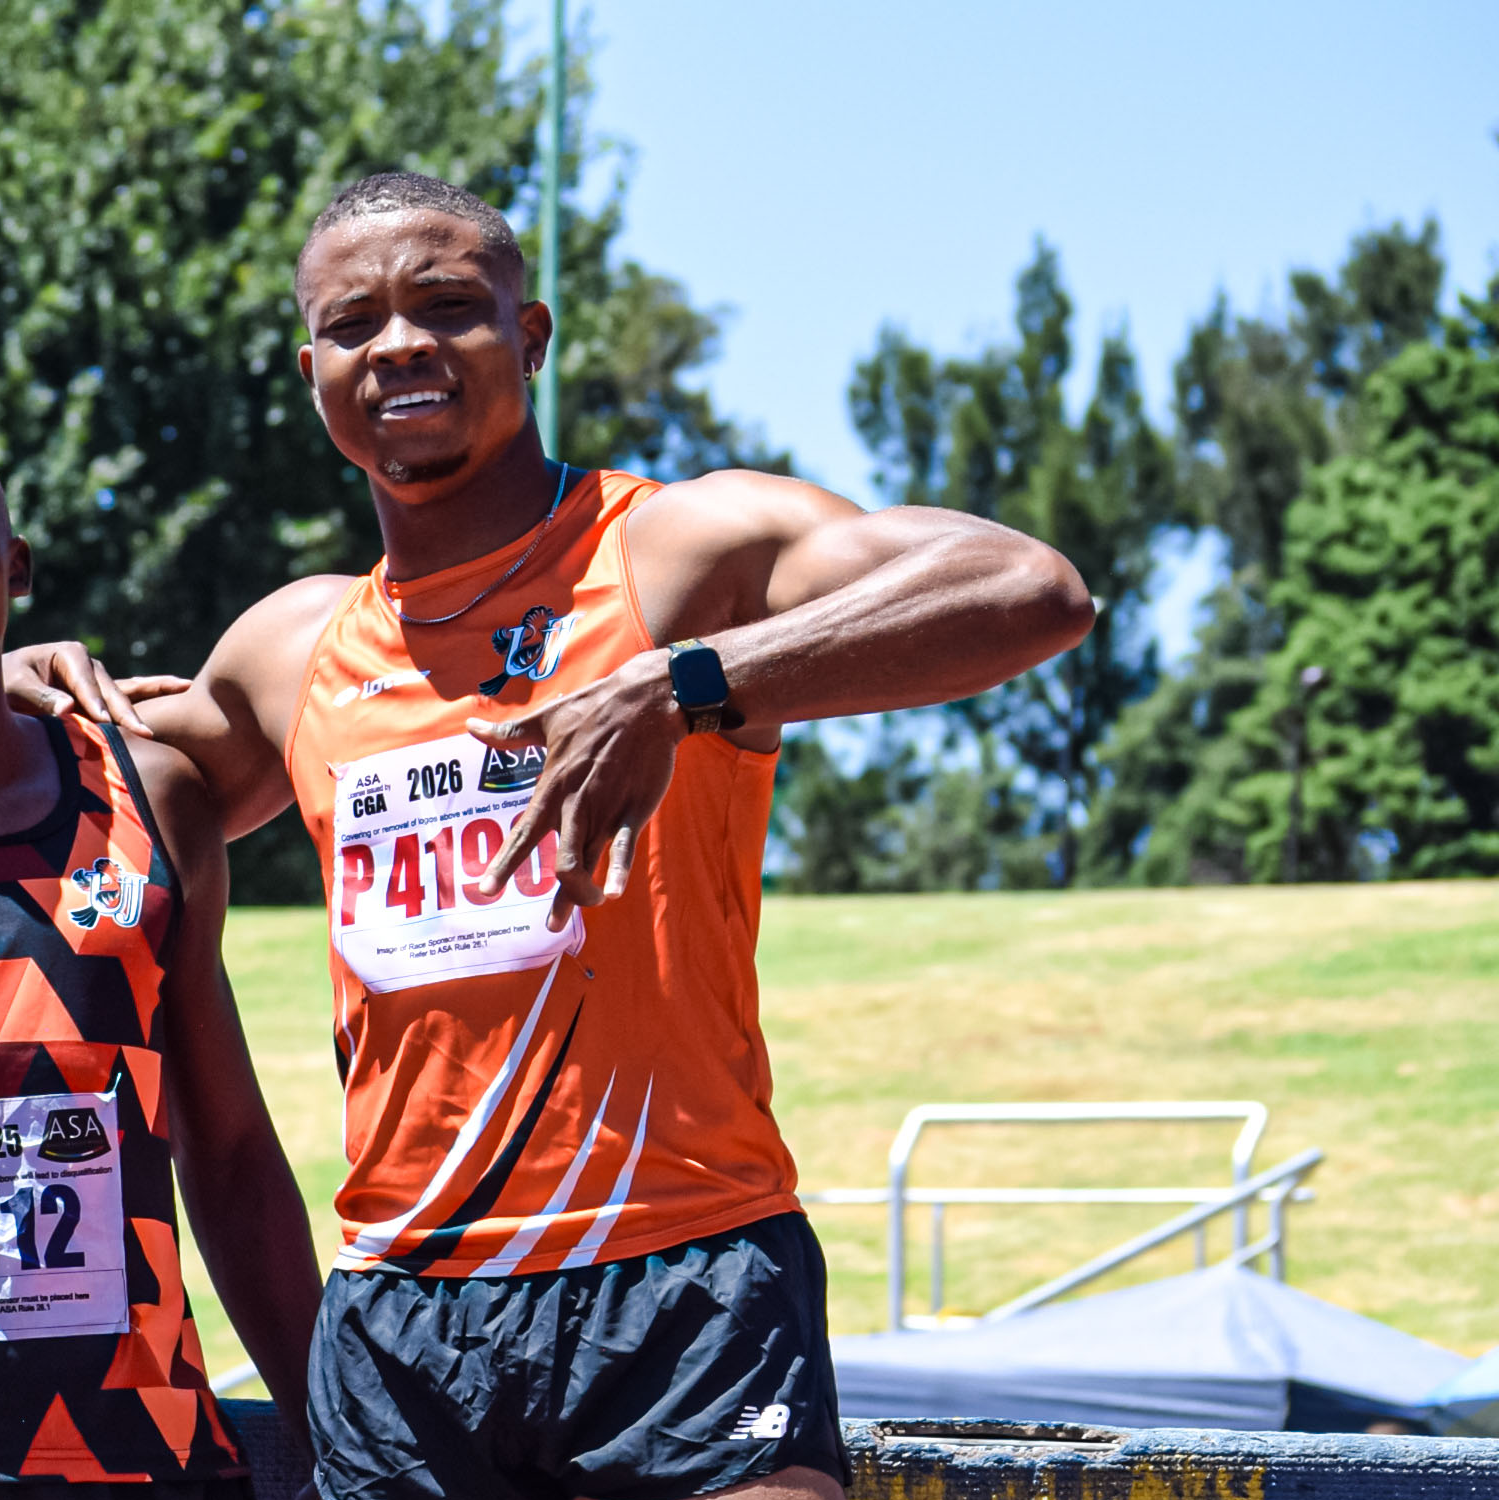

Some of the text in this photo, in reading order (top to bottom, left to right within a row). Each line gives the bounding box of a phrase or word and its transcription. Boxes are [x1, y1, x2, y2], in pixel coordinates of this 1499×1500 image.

[356, 773, 381, 789] ASA
[407, 759, 463, 802] 2026
[353, 793, 388, 819] CGA
[341, 830, 372, 843] Covering
[382, 820, 409, 834] removal
[475, 804, 491, 813] lead
[408, 942, 427, 950] Race
[457, 932, 475, 941] must
[476, 931, 486, 939] be
[487, 927, 512, 938] placed
[437, 945, 453, 954] ASA
[454, 942, 471, 951] Rule
[49, 1114, 101, 1140] ASA
[51, 1171, 59, 1179] to
[0, 1304, 17, 1313] ASA
